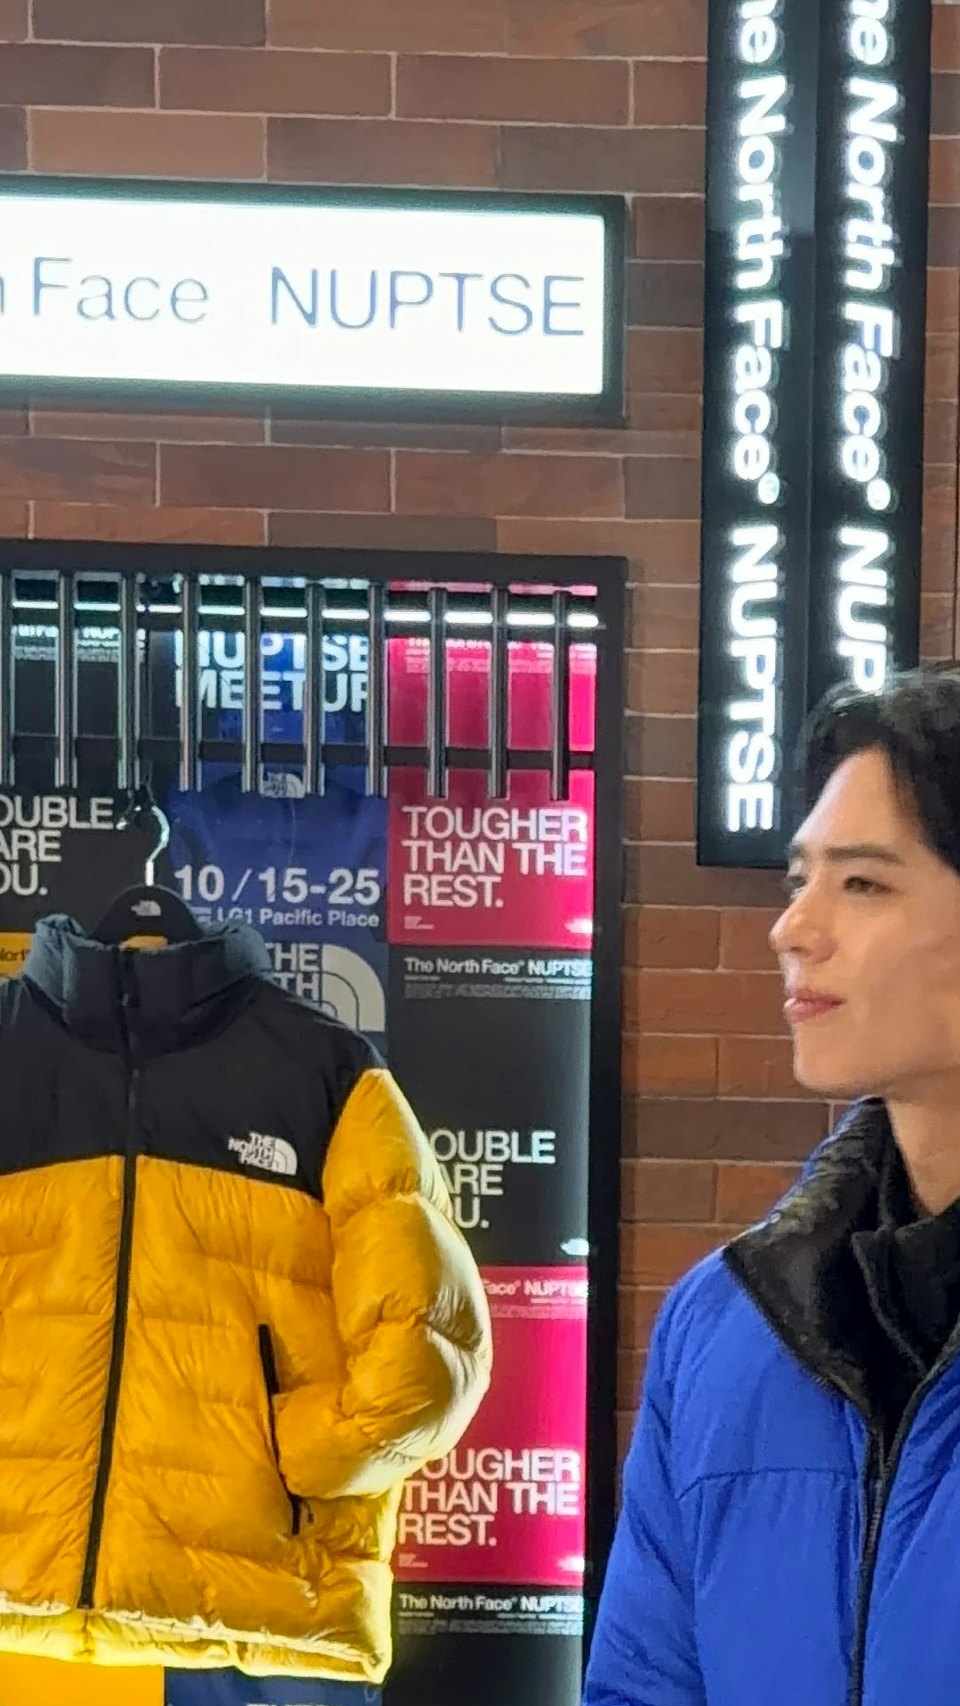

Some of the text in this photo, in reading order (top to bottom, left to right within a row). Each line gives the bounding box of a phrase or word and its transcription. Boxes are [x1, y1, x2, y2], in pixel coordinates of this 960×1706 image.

[736, 74, 787, 290] North
[844, 75, 899, 290] North
[31, 256, 585, 337] Face NUPTSE
[838, 526, 889, 692] NUP
[728, 523, 779, 832] NUPTSE
[402, 806, 588, 842] TOUGHER
[401, 840, 588, 876] THAN THE
[403, 874, 504, 908] REST.
[259, 908, 323, 926] Pacific
[327, 909, 380, 927] Place
[265, 943, 320, 971] HE
[404, 957, 434, 973] The
[436, 957, 480, 974] North
[527, 958, 593, 976] NUPTSE
[430, 1128, 556, 1164] OUBLE
[439, 1163, 504, 1196] RE
[421, 1447, 581, 1482] OUGHER
[403, 1481, 581, 1516] THAN THE
[398, 1513, 498, 1546] REST.
[399, 1593, 428, 1609] The
[430, 1594, 473, 1610] North
